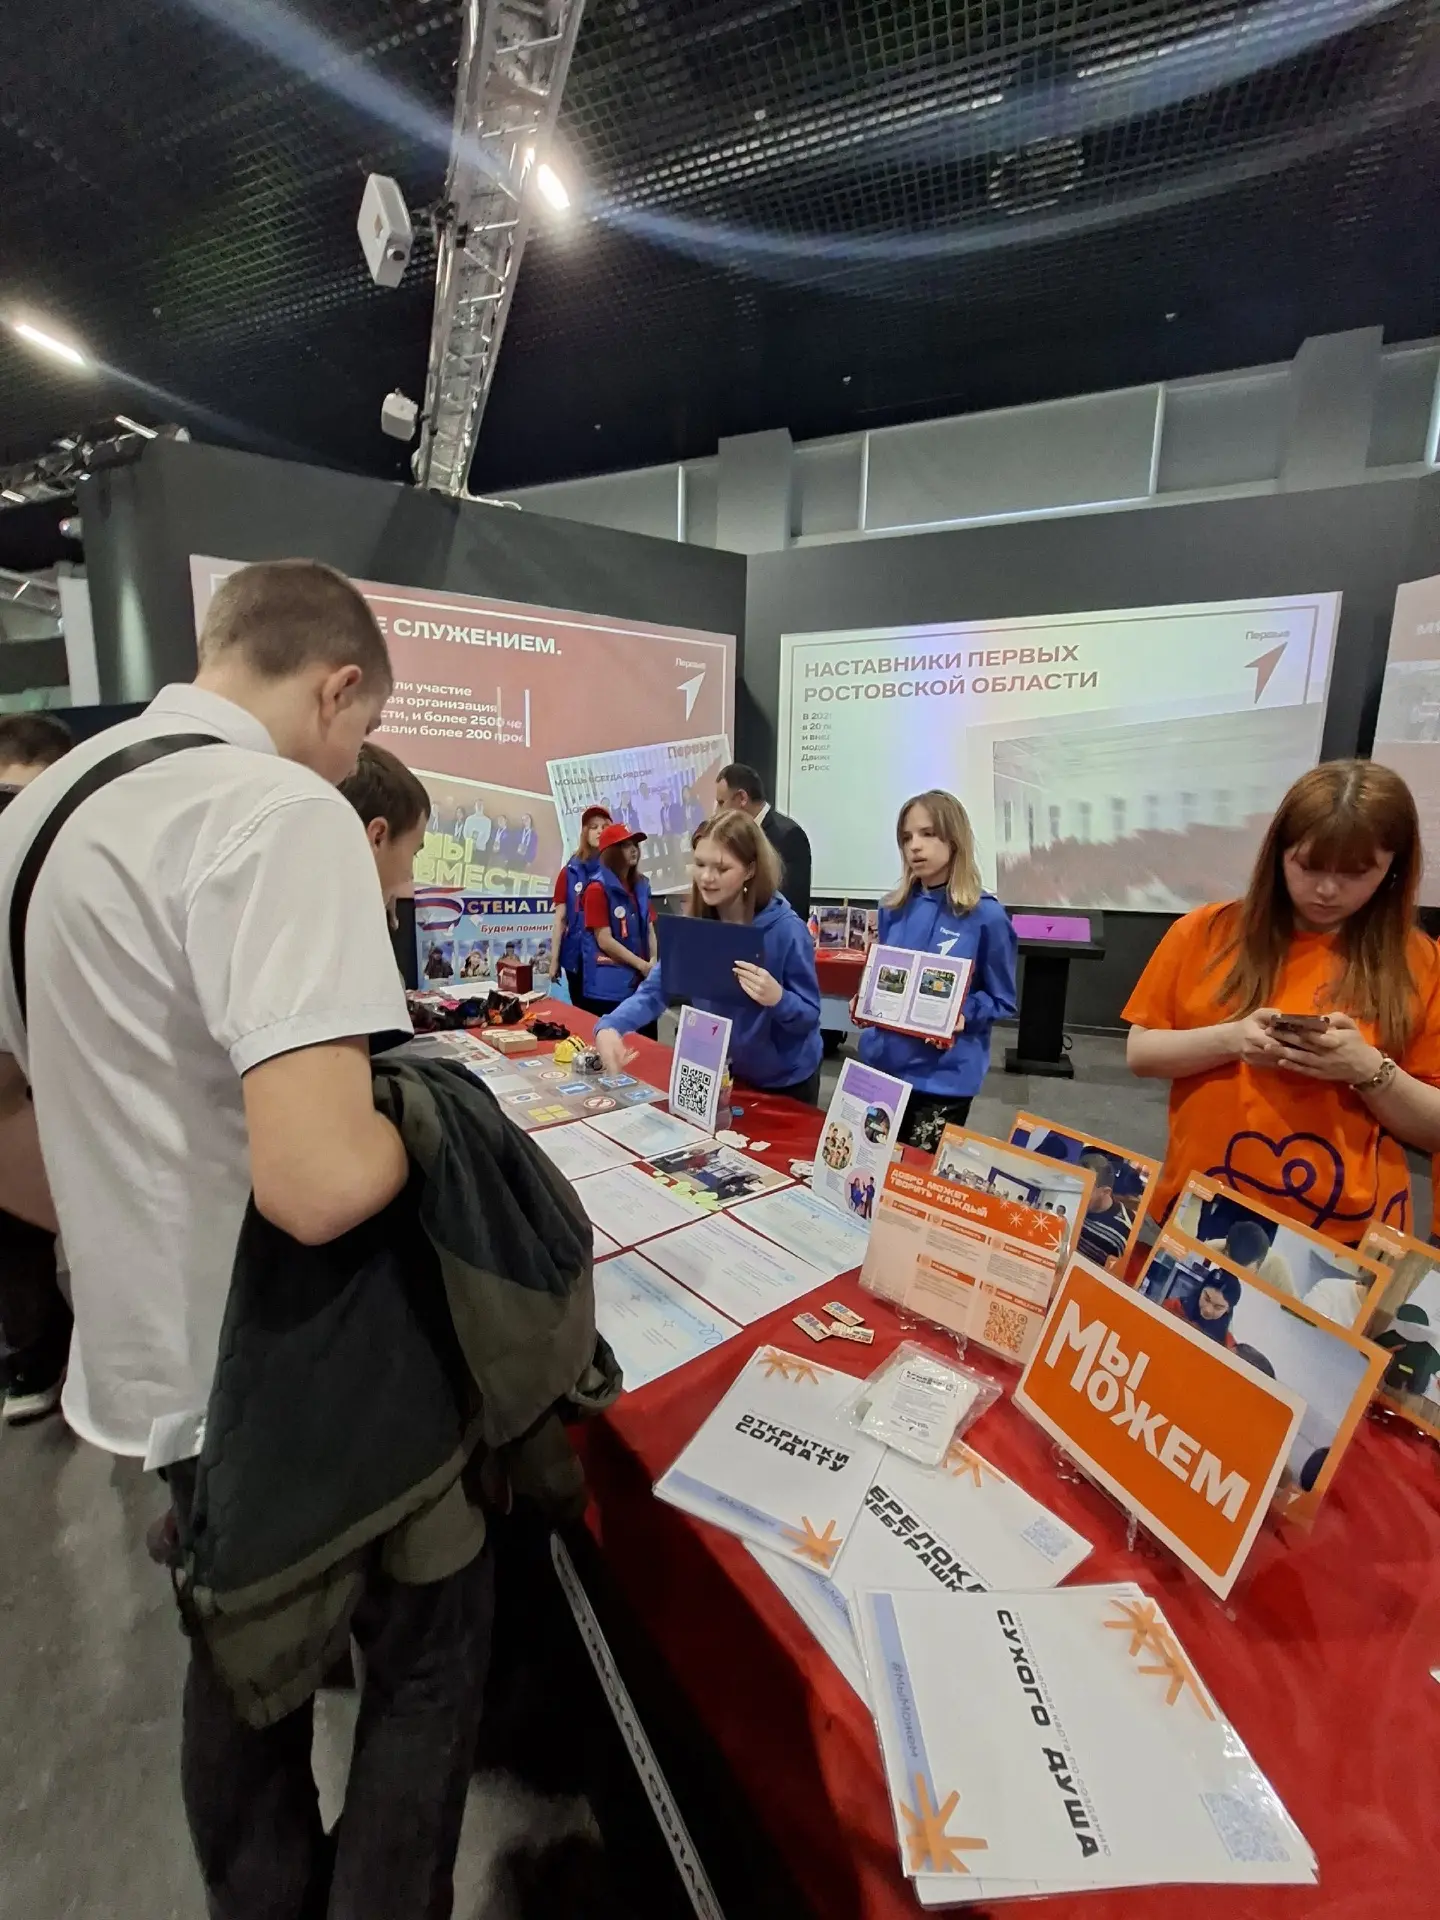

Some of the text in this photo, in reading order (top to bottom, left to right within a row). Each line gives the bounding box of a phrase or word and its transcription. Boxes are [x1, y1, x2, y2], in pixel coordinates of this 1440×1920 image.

[393, 617, 562, 655] СЛУЖЕНИЕМ.
[804, 644, 1080, 678] НАСТАВНИКИ ПЕРВЫХ
[416, 683, 473, 697] участие
[804, 671, 1099, 703] РОСТОВСКОЙ ОБЛАСТИ
[407, 697, 499, 713] организация
[424, 711, 468, 725] более
[470, 715, 504, 729] 2500
[420, 725, 464, 739] более
[466, 729, 493, 741] 200
[412, 857, 551, 896] ВМЕСТЕ
[467, 899, 531, 915] СТЕНА
[480, 923, 553, 935] Будем помнит
[890, 1177, 933, 1199] ТВОРИТЬ
[936, 1192, 989, 1218] КАЖДЫЙ
[926, 1180, 970, 1202] МОЖЕТ
[735, 1421, 845, 1472] СОЛДАТУ
[740, 1414, 850, 1464] ОТКРЫТКИ
[864, 1497, 966, 1593] ЧЕБУРАШК
[997, 1609, 1100, 1859] СУХОГО ДУША
